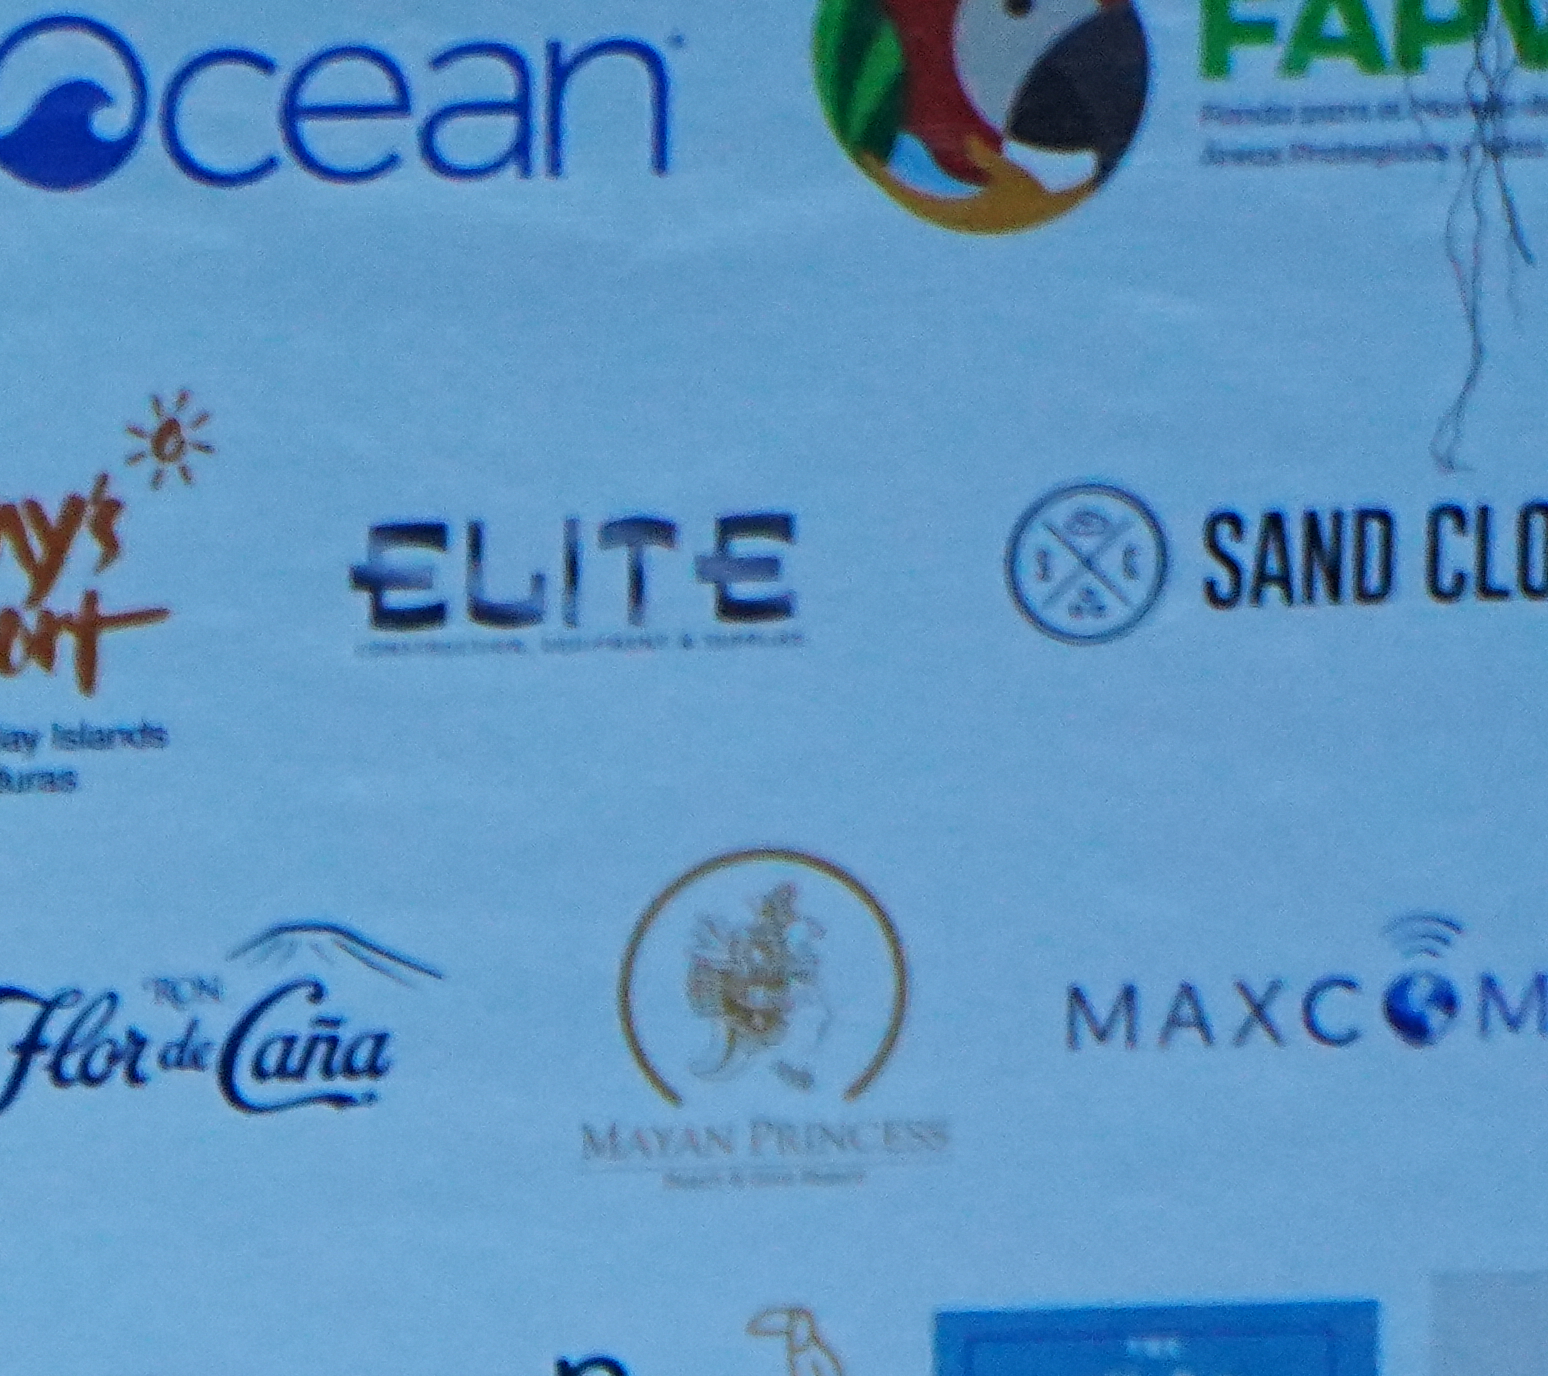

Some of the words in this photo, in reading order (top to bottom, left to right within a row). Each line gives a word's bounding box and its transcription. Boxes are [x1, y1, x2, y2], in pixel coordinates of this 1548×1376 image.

[1201, 0, 1548, 81] FAP
[348, 510, 798, 631] ELITE
[1201, 507, 1396, 611] SAND
[52, 719, 170, 751] Islands
[156, 1017, 216, 1073] de
[216, 974, 394, 1115] Caña
[579, 1121, 735, 1162] MAYAN
[748, 1117, 953, 1156] PRINCESS
